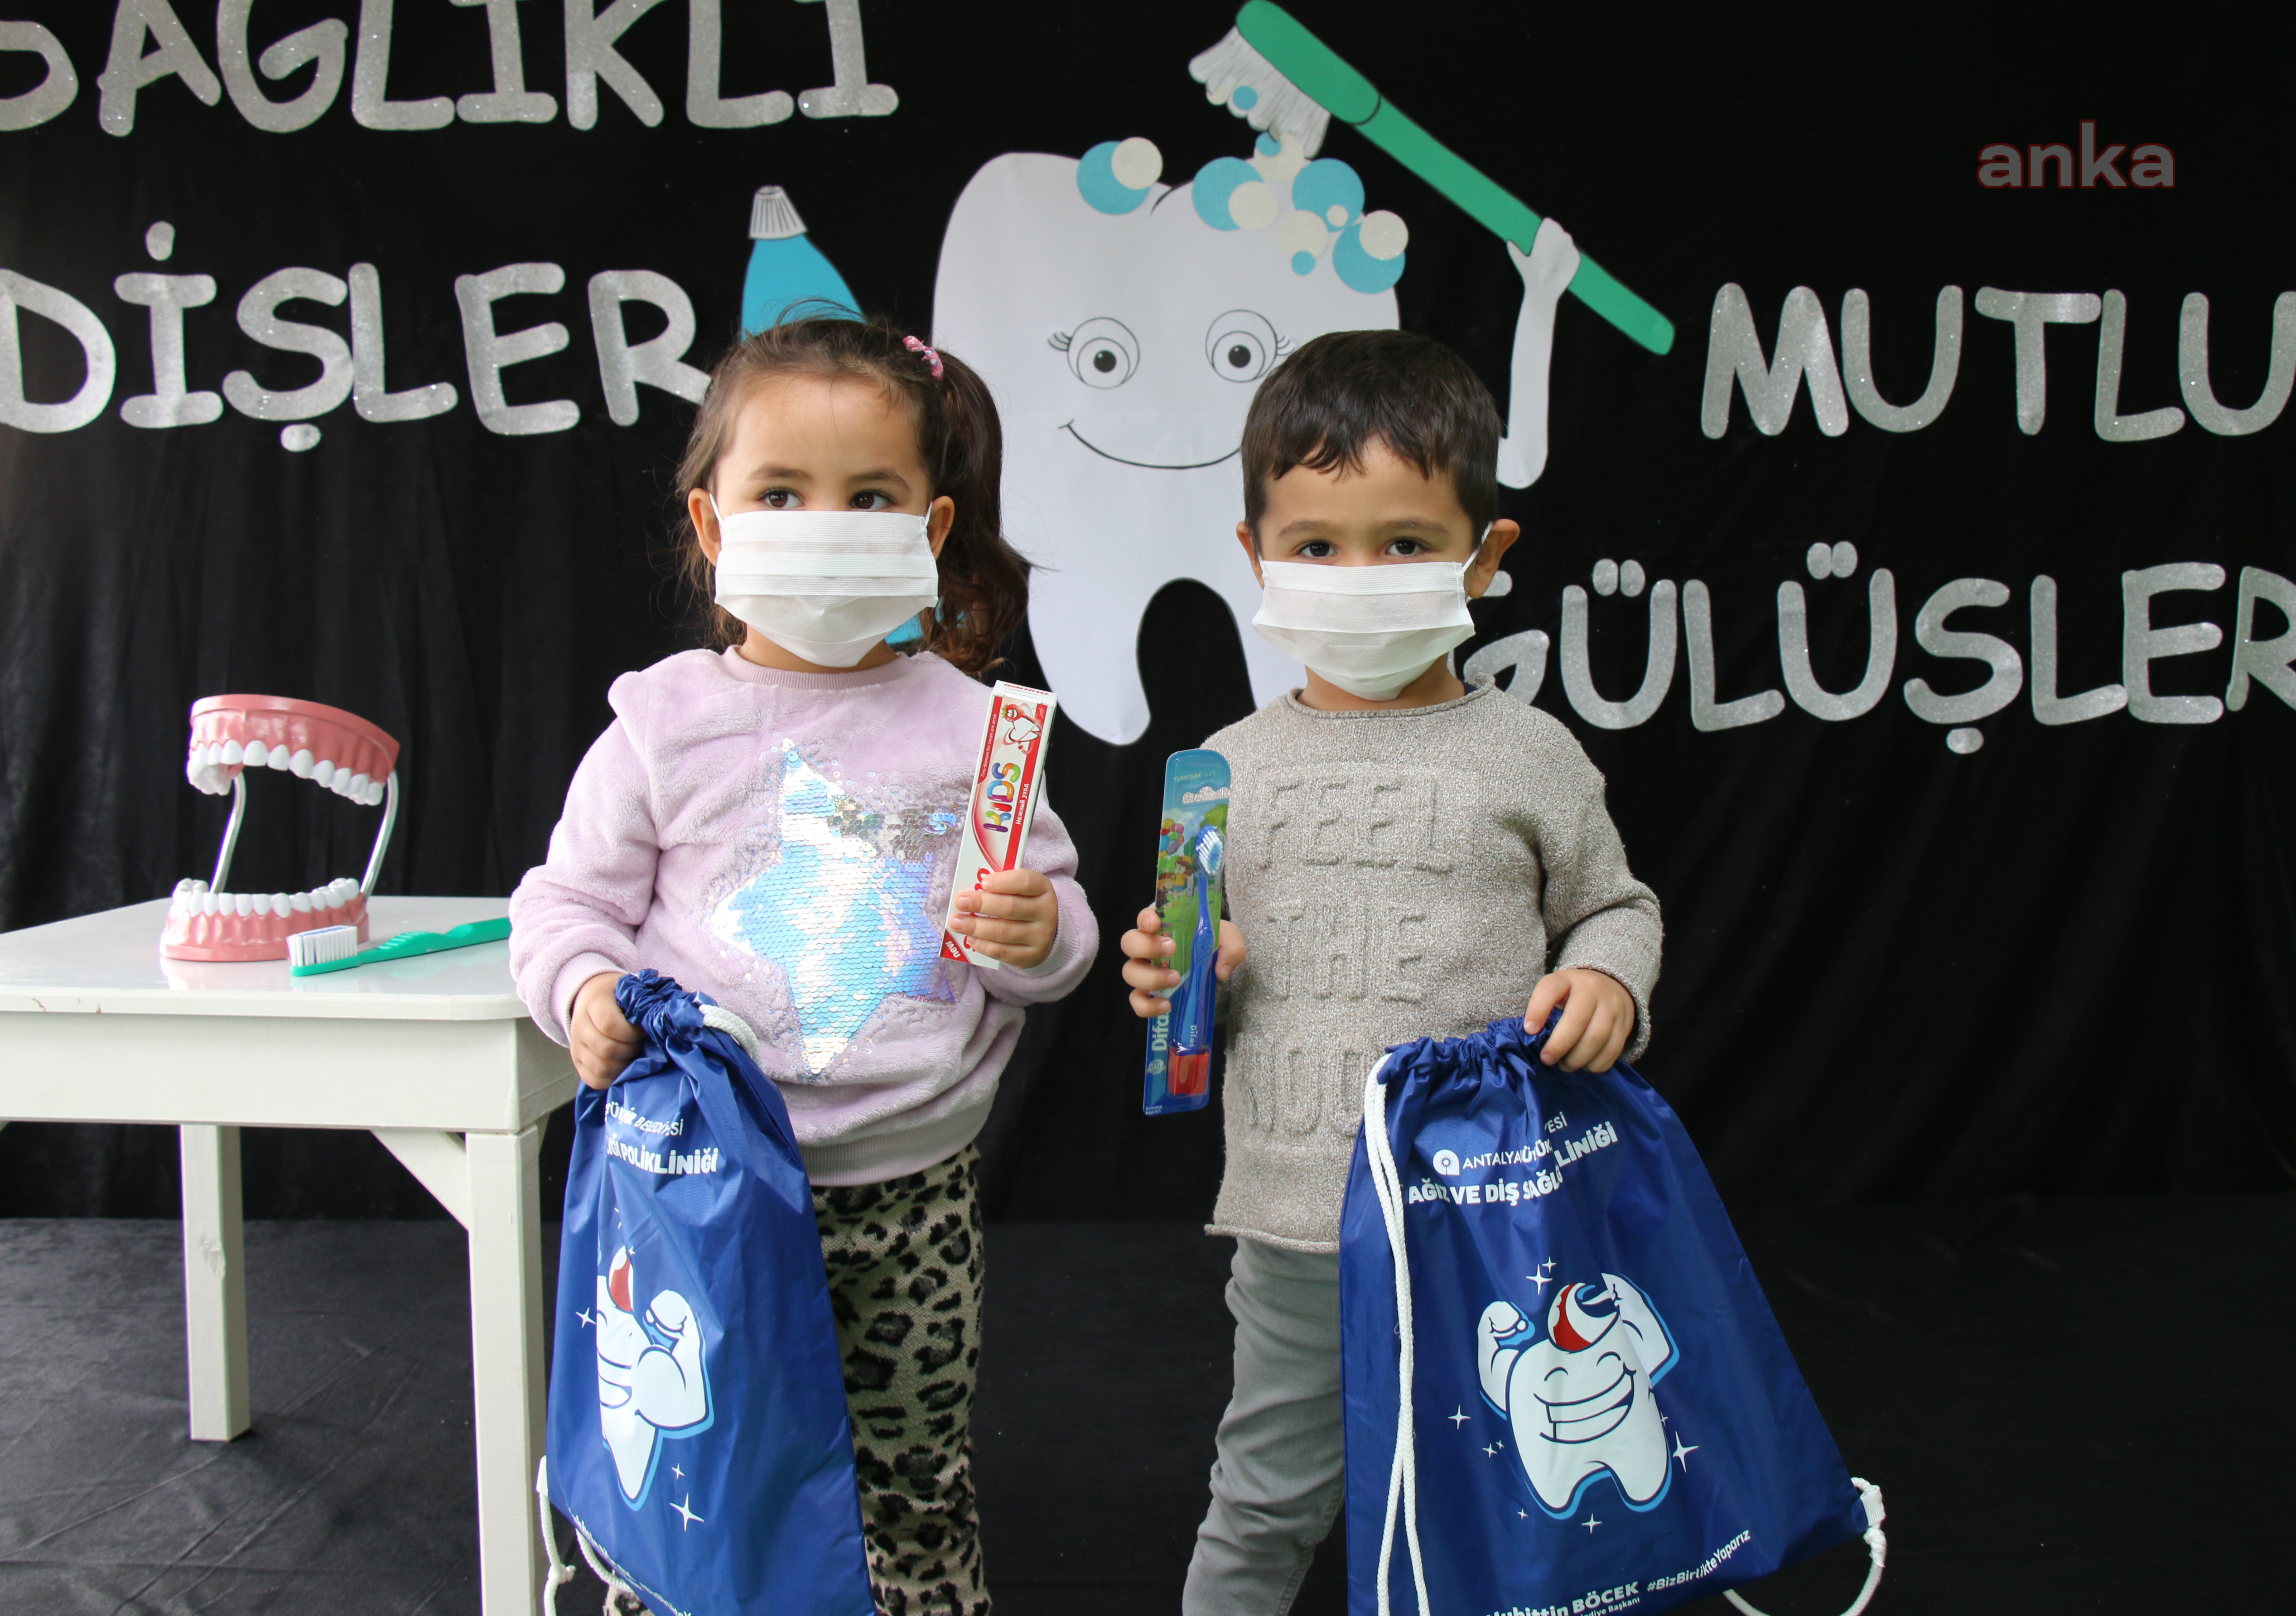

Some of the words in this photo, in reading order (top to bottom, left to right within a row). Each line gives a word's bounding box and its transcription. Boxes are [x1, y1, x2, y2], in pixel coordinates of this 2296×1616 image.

[0, 221, 711, 452] DİŞLER
[1701, 283, 2296, 442] MUTLU
[983, 762, 1021, 832] KIDS
[1015, 800, 1026, 825] Нежный
[1022, 784, 1030, 799] уход
[945, 941, 961, 958] new
[1152, 1009, 1171, 1051] Difa
[620, 1142, 719, 1175] POLİKLİNİĞİ
[1462, 1150, 1521, 1169] ANTALYA
[1408, 1178, 1450, 1204] AĞIZ
[1449, 1184, 1481, 1205] VE
[1486, 1178, 1519, 1207] DİŞ
[1646, 1529, 1751, 1592] #BizBirlikteYaparız
[1572, 1581, 1639, 1614] BÖCEK
